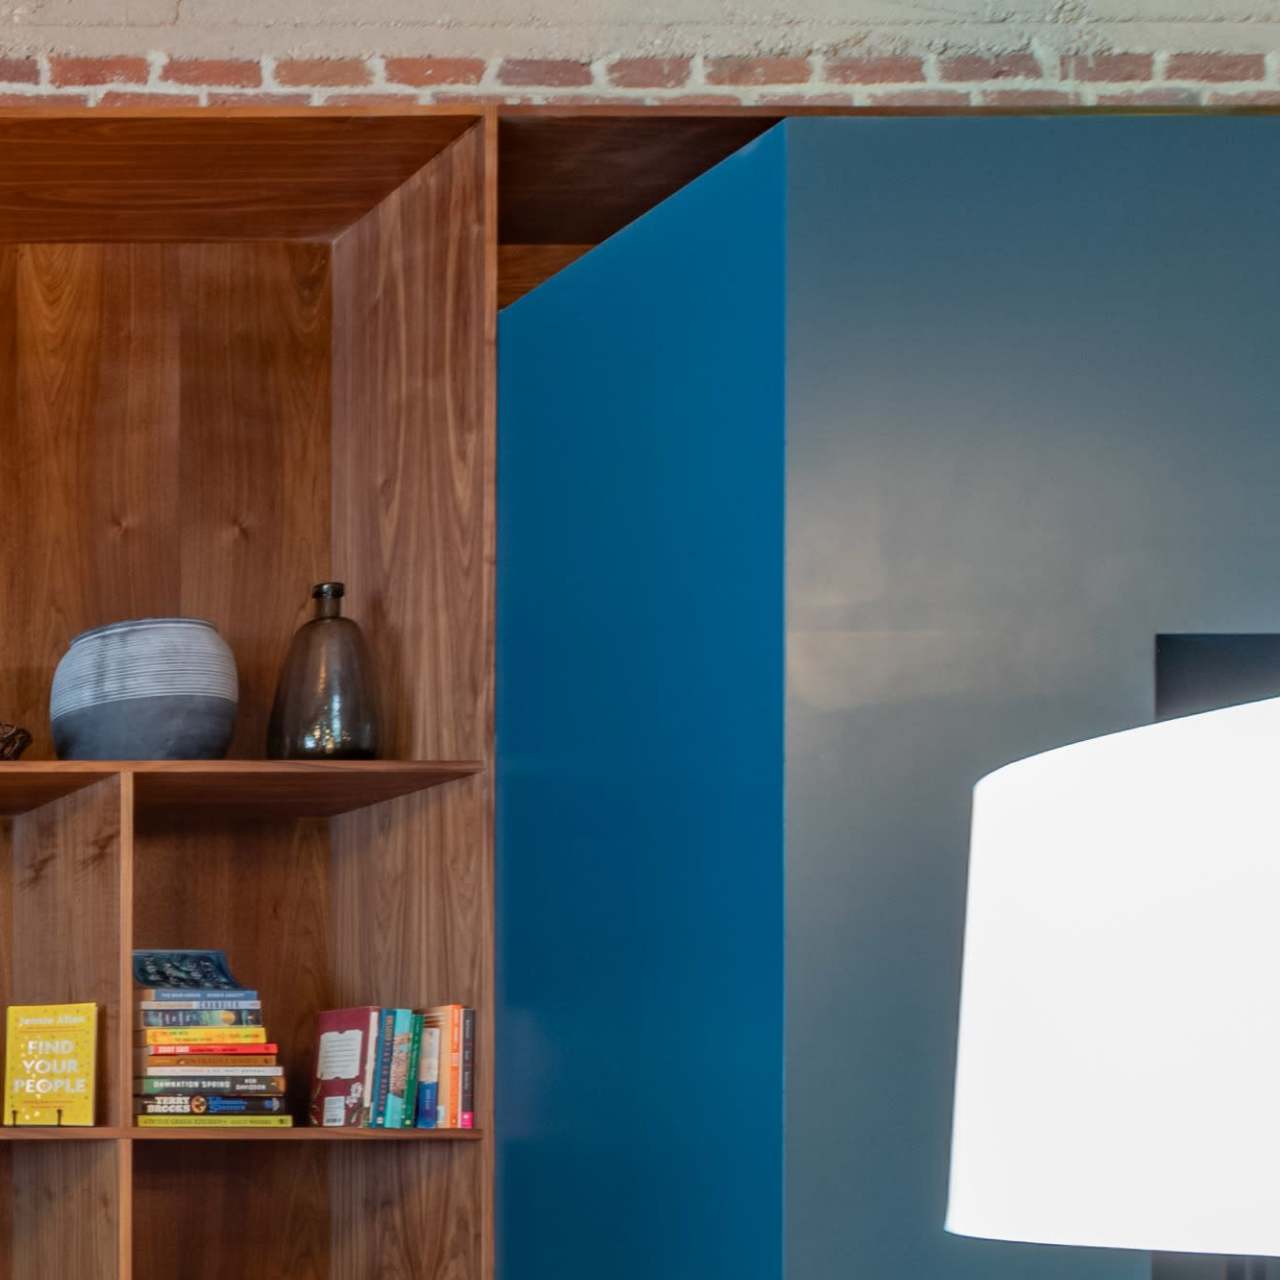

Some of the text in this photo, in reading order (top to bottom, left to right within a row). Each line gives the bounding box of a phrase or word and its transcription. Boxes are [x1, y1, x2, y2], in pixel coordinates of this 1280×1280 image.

[27, 1039, 75, 1055] FIND
[22, 1058, 80, 1074] YOUR
[12, 1078, 88, 1094] PEOPLE
[153, 1080, 231, 1089] DAMNATION SPRING
[154, 1096, 191, 1105] TERRY
[146, 1104, 191, 1113] BROOKS
